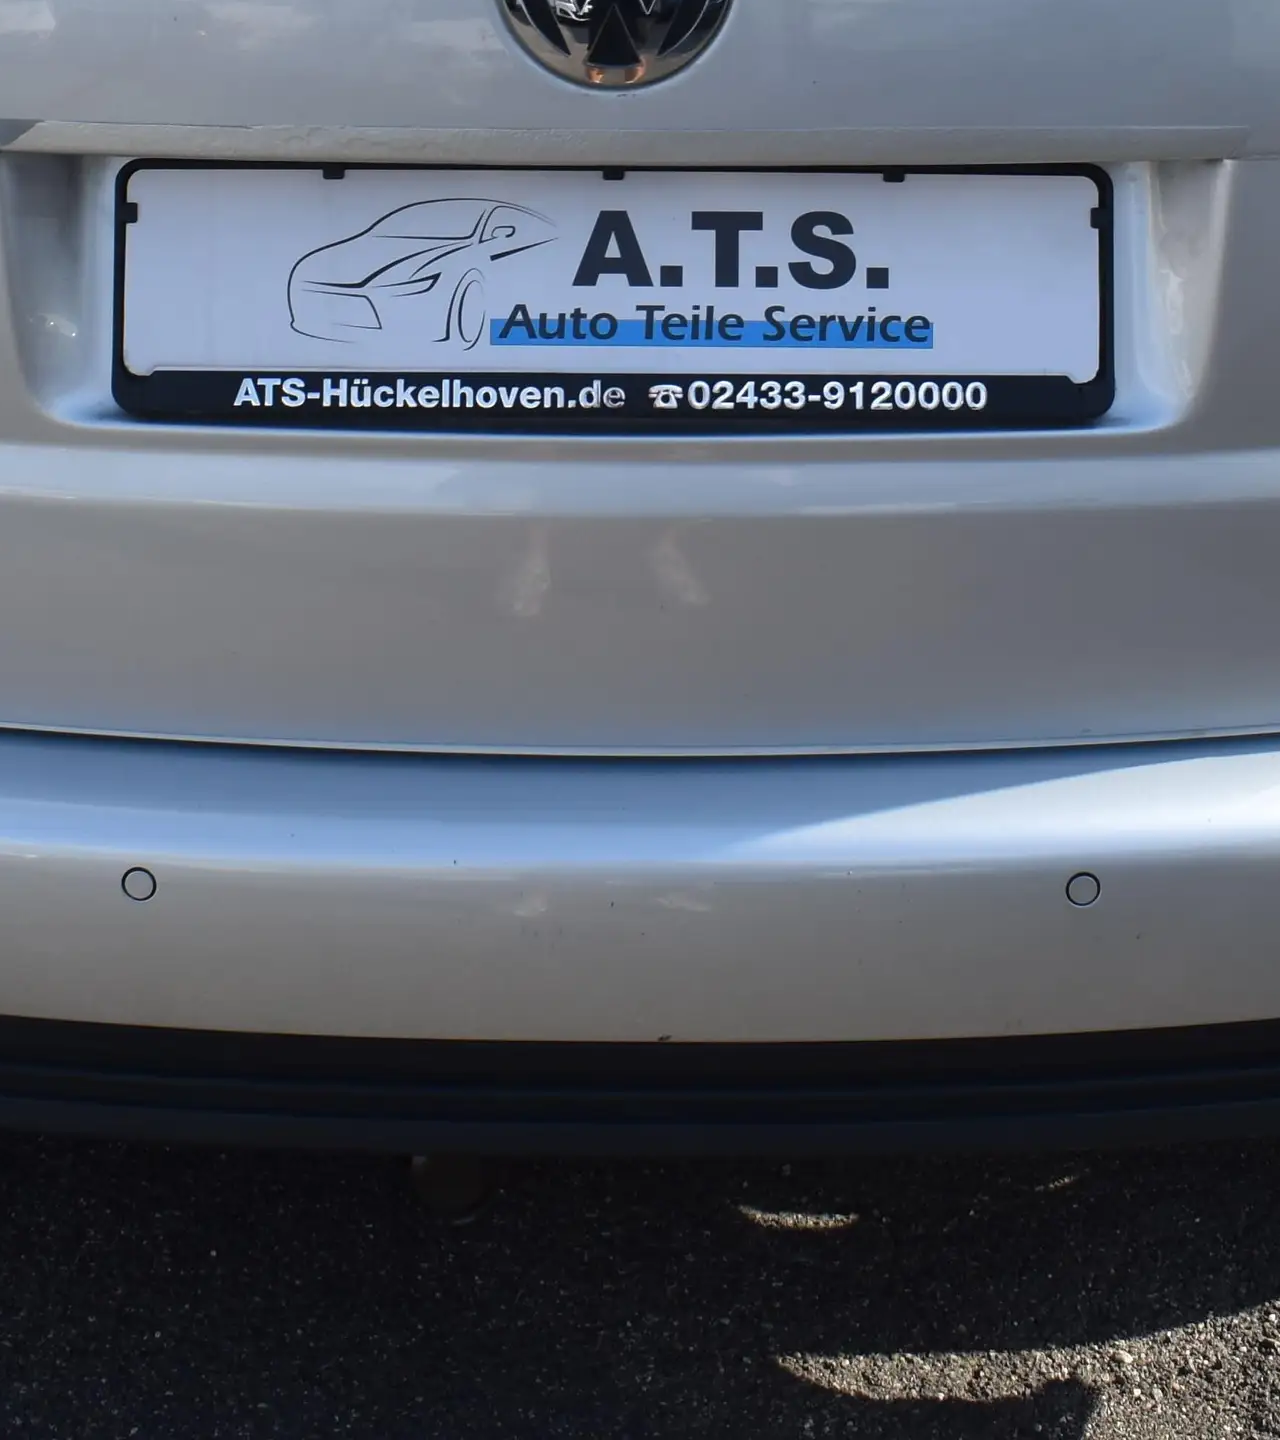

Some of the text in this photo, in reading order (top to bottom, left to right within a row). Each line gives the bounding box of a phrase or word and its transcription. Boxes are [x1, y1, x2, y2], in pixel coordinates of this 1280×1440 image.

[572, 210, 889, 290] A.T.S.
[498, 303, 931, 343] Auto Teile Service
[232, 377, 988, 411] ATS-Hückelhoven.de 02433-9120000
